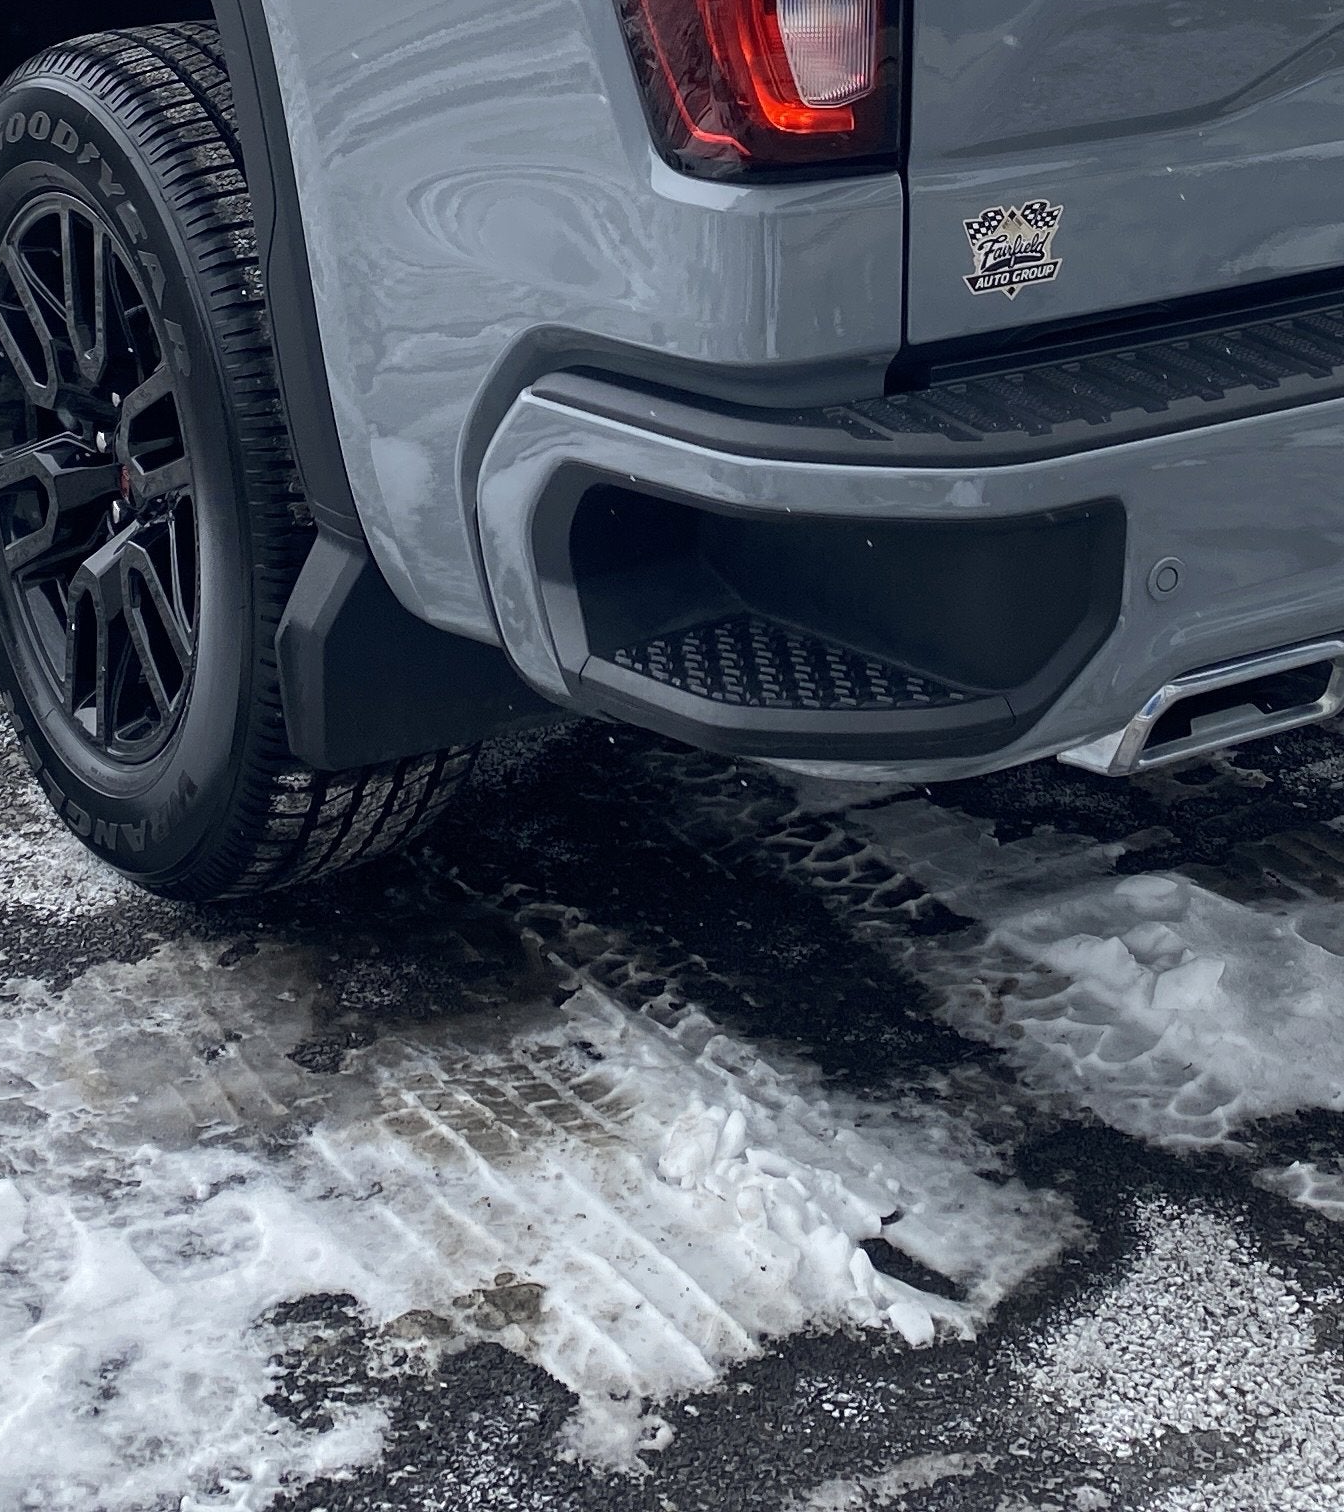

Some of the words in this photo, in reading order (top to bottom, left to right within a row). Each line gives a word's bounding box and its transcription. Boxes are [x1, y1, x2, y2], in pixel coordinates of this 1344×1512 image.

[977, 231, 1051, 271] Fairfield
[975, 273, 1010, 290] AUTO
[1012, 263, 1055, 283] GROUP
